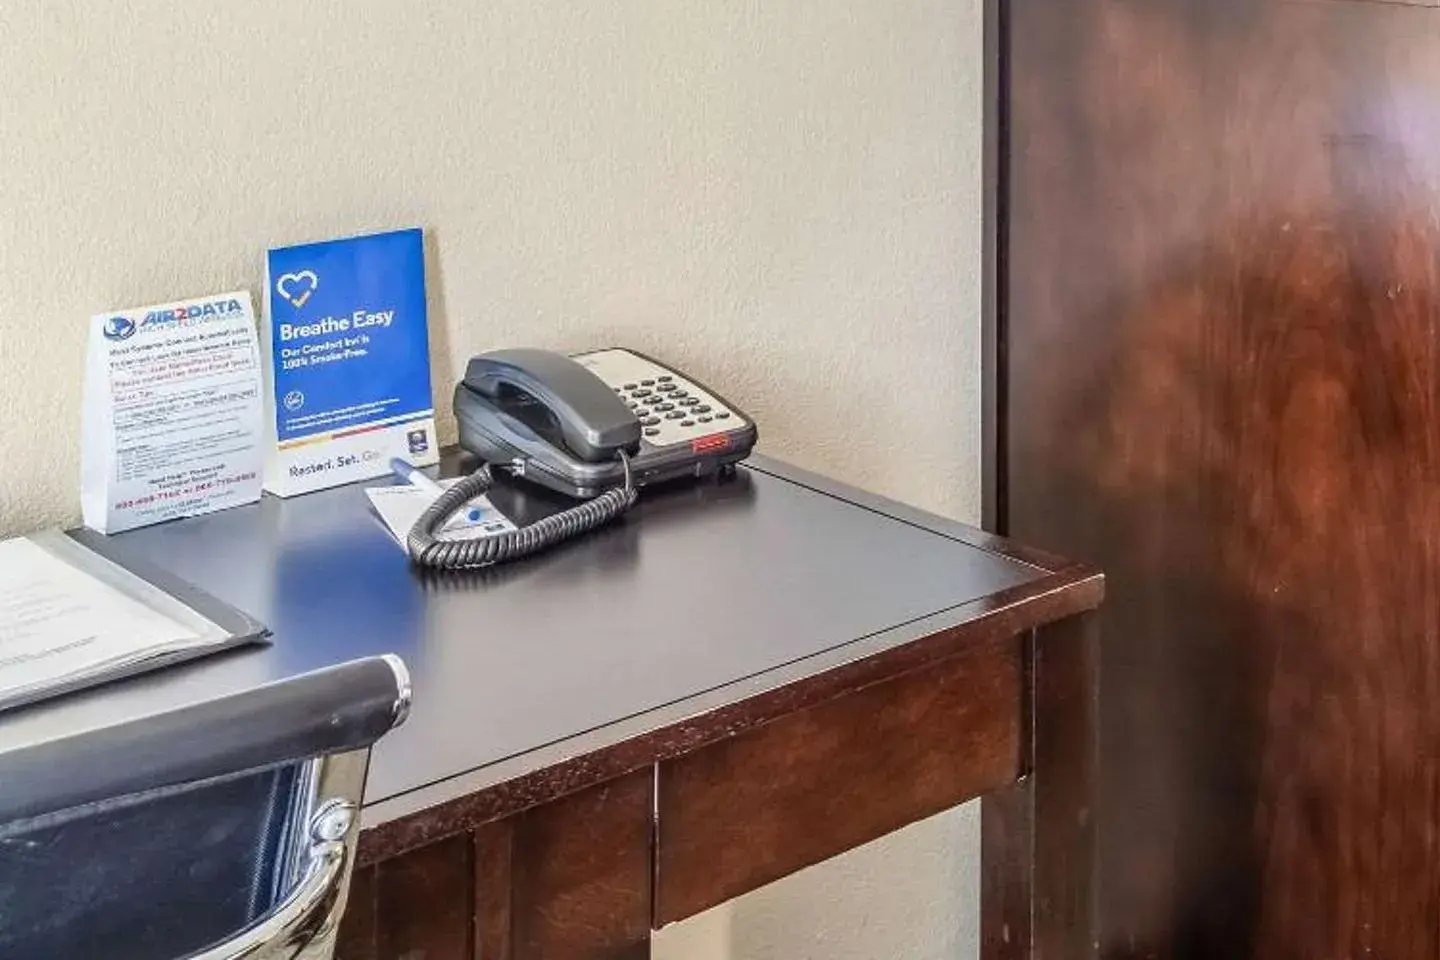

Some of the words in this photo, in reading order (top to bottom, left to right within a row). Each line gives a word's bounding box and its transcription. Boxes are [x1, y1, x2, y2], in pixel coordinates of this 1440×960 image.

[139, 299, 242, 327] AIR2DATA
[279, 315, 350, 341] Breathe
[352, 309, 395, 330] Easy
[281, 348, 301, 359] Our
[302, 340, 343, 354] Comfort
[282, 358, 308, 370] 100%
[336, 453, 360, 468] Set.
